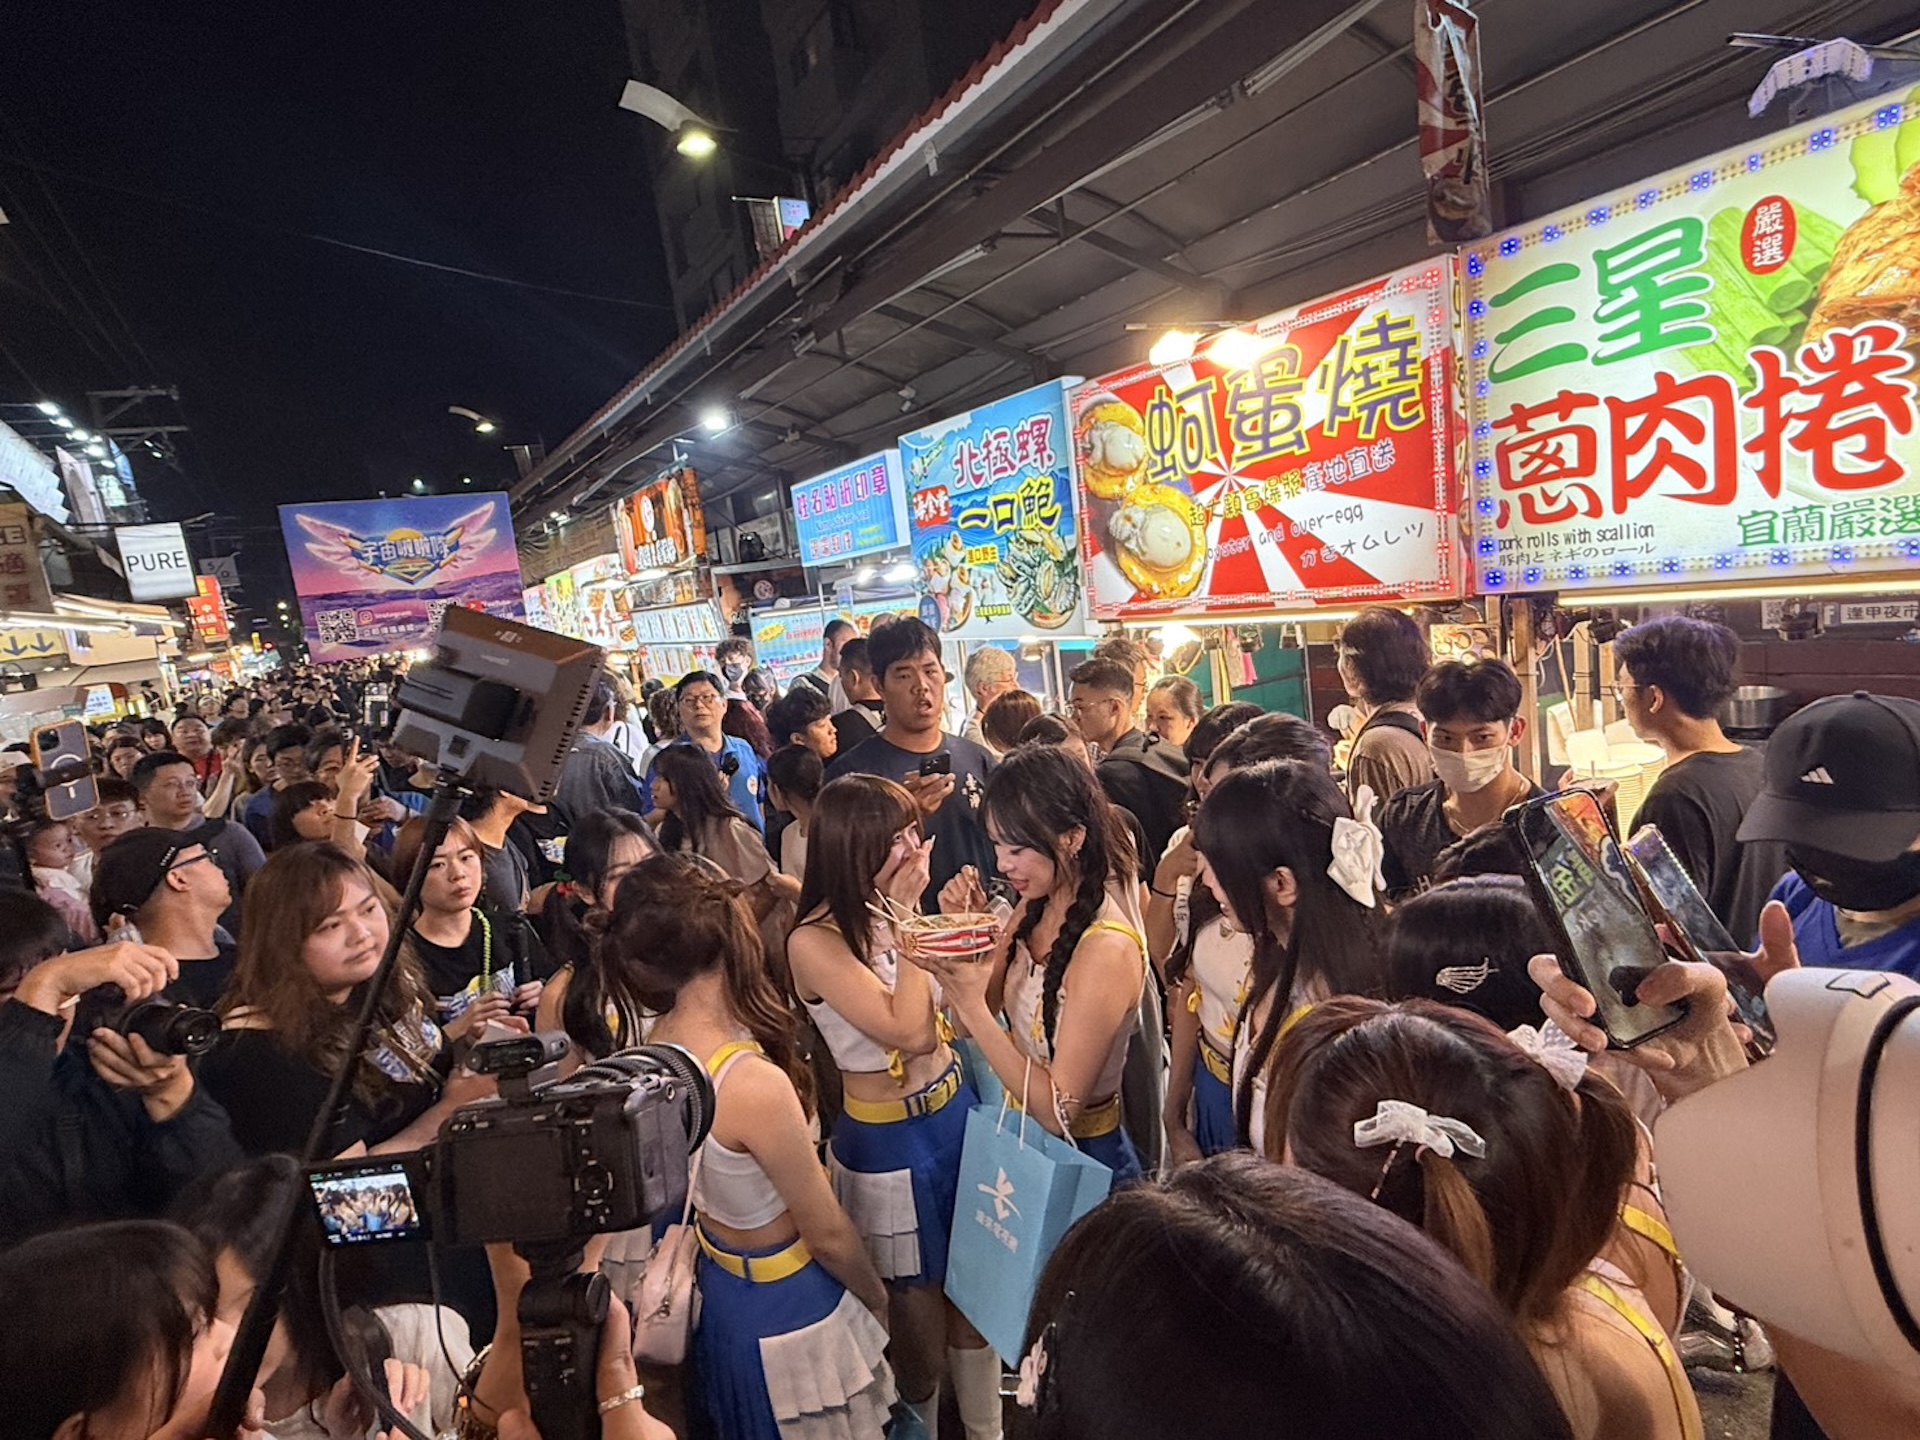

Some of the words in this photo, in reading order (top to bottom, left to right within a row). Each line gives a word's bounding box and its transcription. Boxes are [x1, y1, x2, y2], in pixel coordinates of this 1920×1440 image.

[1751, 204, 1787, 269] 嚴選
[1488, 216, 1716, 384] 三星
[1145, 310, 1426, 482] 蚵蛋燒
[1490, 322, 1915, 528] 蔥肉捲
[953, 414, 1057, 490] 北極螺
[959, 476, 1061, 534] 一口鮑
[1207, 539, 1251, 561] oyster
[1258, 522, 1285, 544] and
[1291, 503, 1364, 538] over-egg
[1737, 493, 1920, 547] 宜蘭嚴選
[126, 551, 188, 573] PURE
[1498, 536, 1523, 552] pork
[1527, 532, 1559, 549] rolls
[1563, 528, 1591, 545] with
[1596, 523, 1655, 543] scallion
[1498, 541, 1657, 567] 豚肉とネギのロール
[1846, 605, 1920, 620] 逢甲夜市
